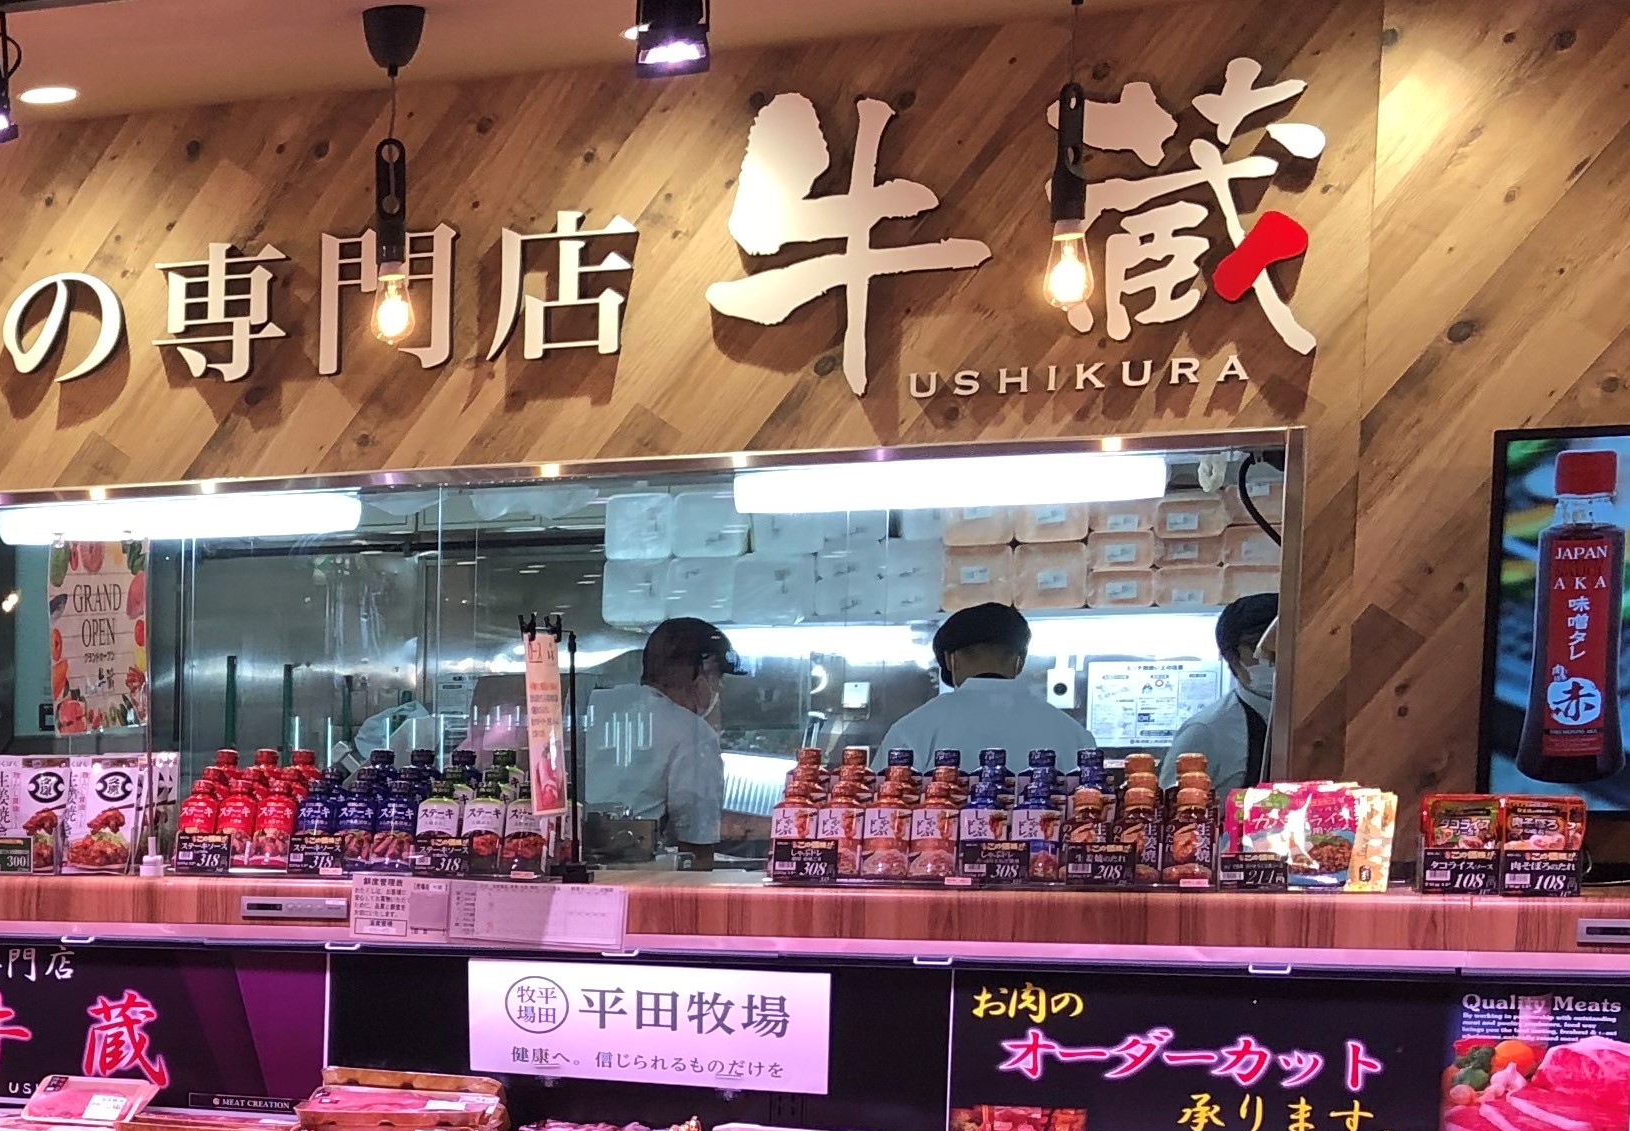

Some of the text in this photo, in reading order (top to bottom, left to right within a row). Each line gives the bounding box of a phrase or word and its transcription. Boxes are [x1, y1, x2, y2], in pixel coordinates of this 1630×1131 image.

[704, 56, 1326, 396] 牛蔵
[909, 354, 1251, 400] USHIKURA
[1554, 546, 1609, 560] JAPAN
[73, 584, 122, 613] GRAND
[81, 618, 116, 647] OPEN
[1568, 596, 1591, 661] 味噌タレ
[1553, 681, 1596, 721] 赤
[180, 807, 213, 818] ステーキ
[220, 807, 250, 818] ステーキ
[258, 807, 293, 818] ステーキ
[298, 807, 330, 818] ステーキ
[338, 807, 374, 818] ステーキ
[379, 808, 414, 819] ステーキ
[420, 808, 454, 819] ステーキ
[467, 808, 501, 819] ステーキ
[1440, 818, 1491, 829] タコライス
[577, 985, 790, 1039] 平田牧場
[970, 982, 1084, 1023] お肉の
[1462, 994, 1622, 1013] Quality Meats
[594, 1050, 784, 1079] 信じられるものだけを
[997, 1028, 1384, 1092] オーダーカット
